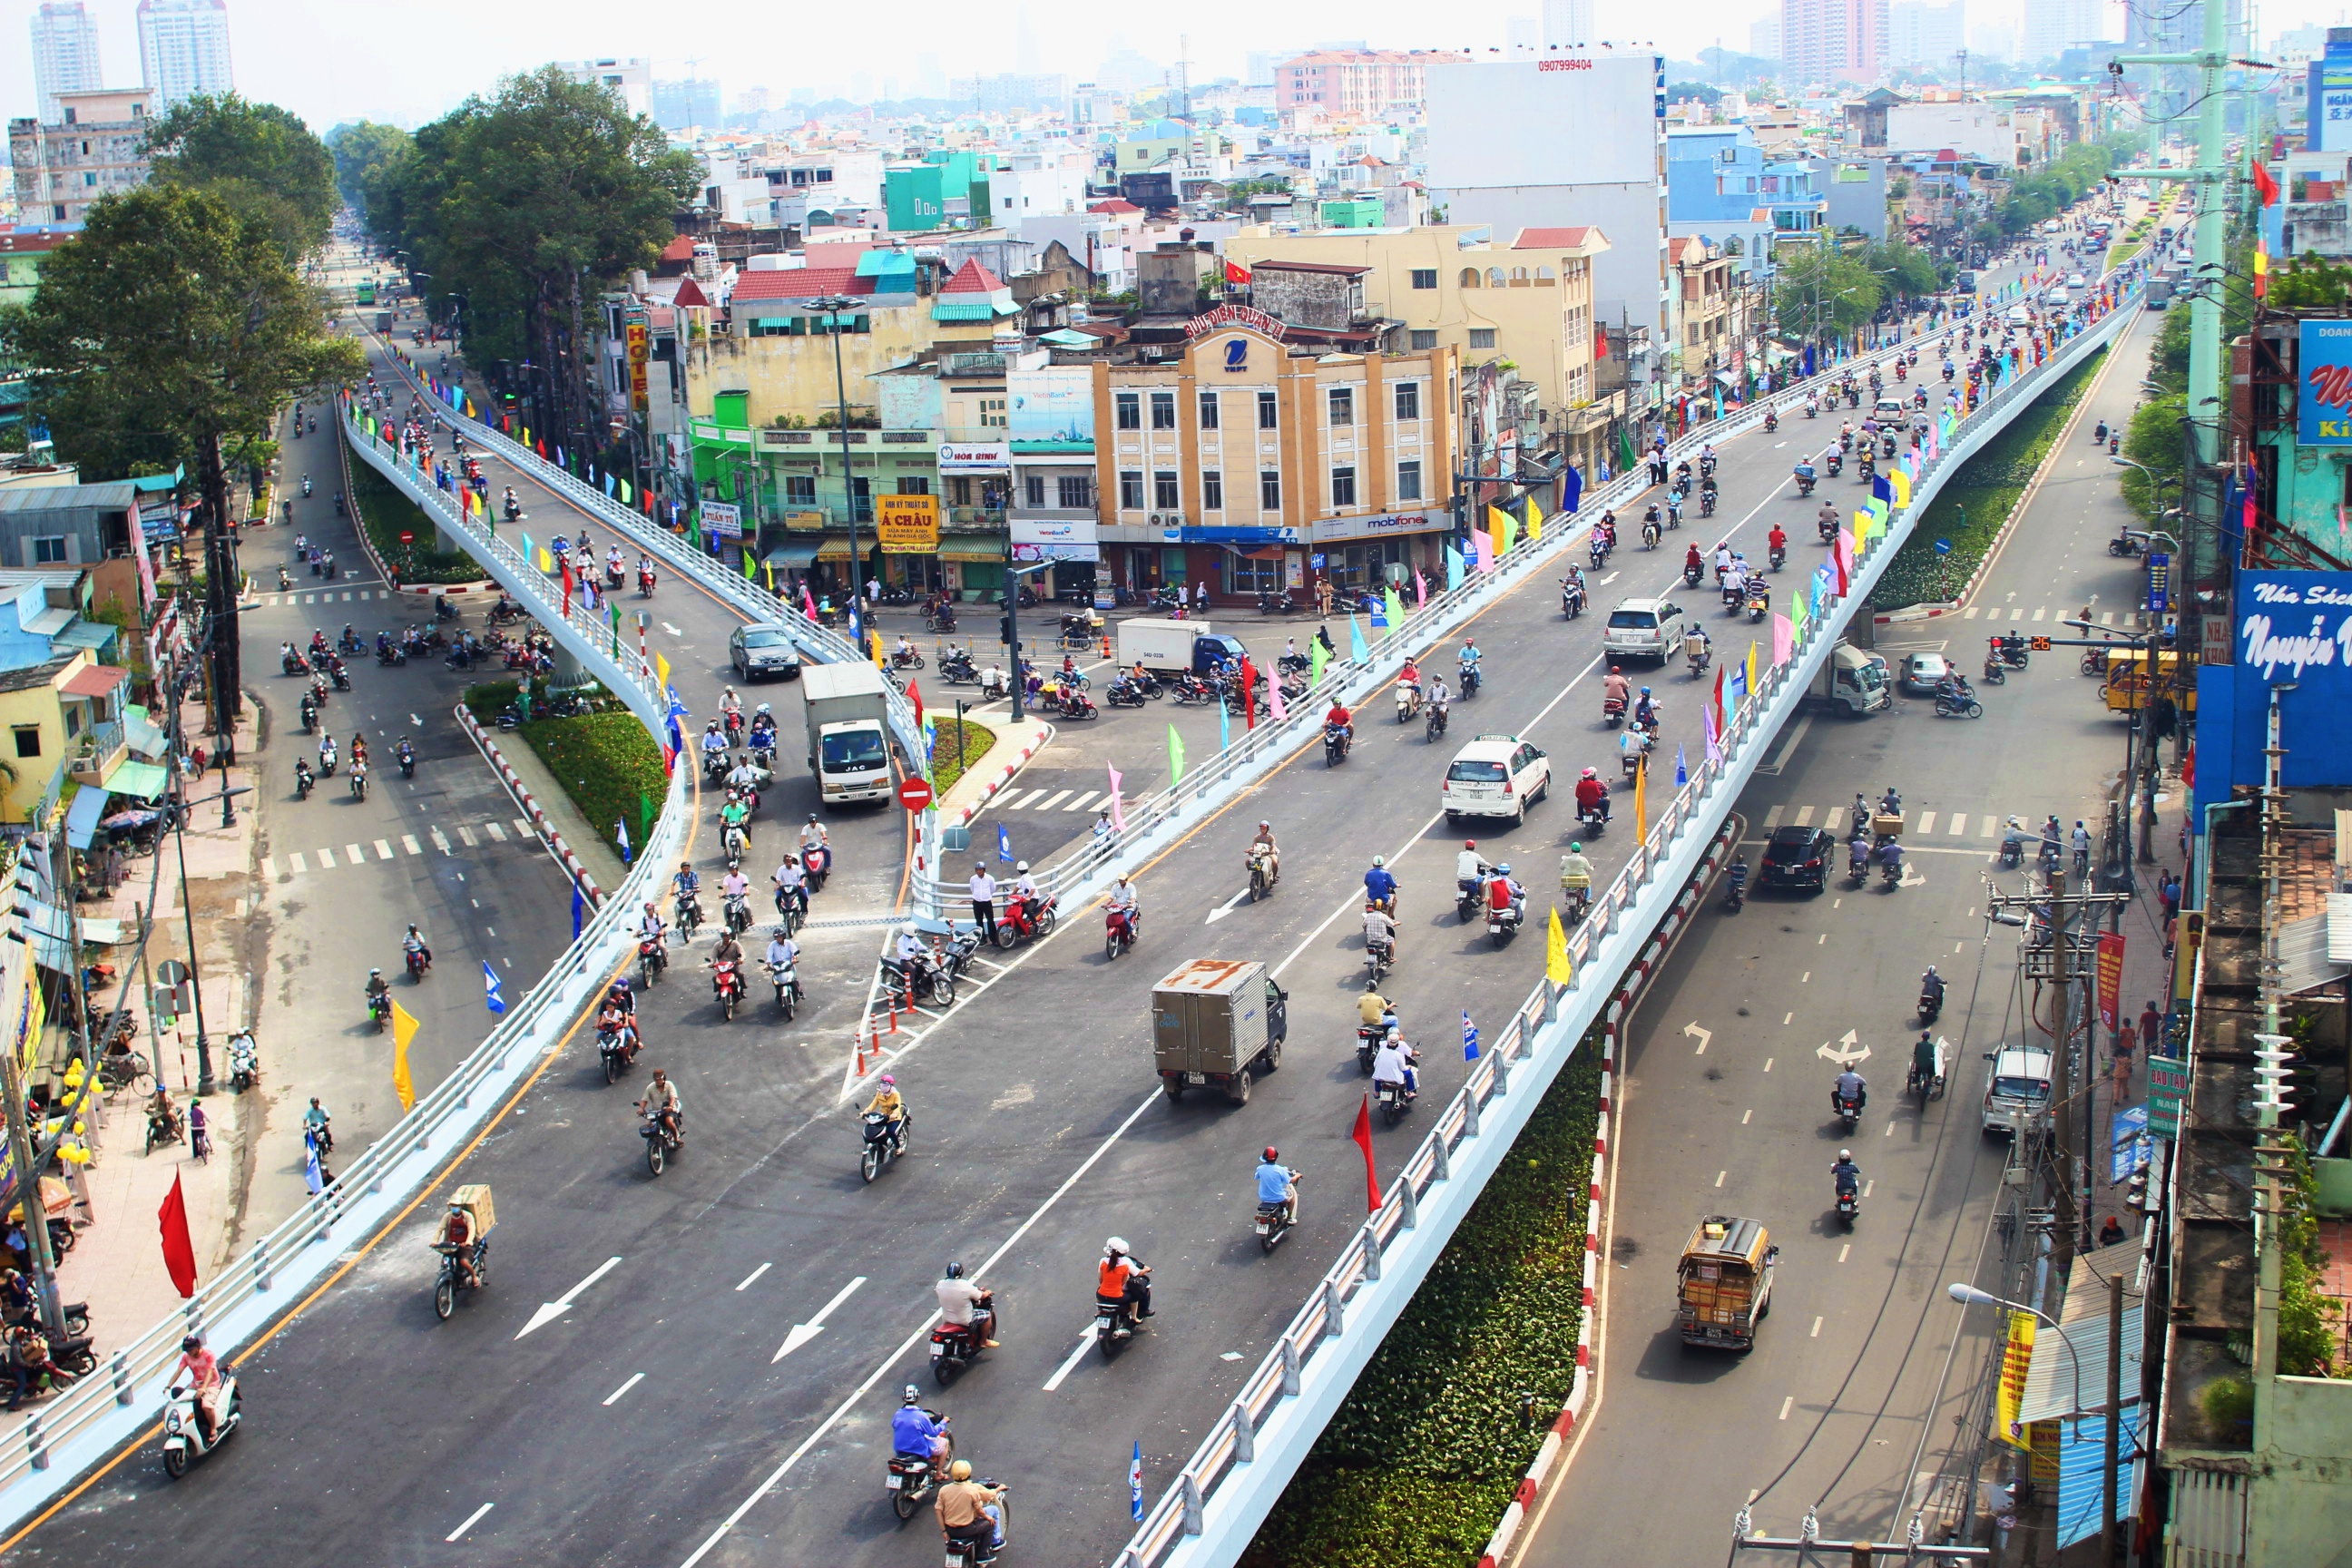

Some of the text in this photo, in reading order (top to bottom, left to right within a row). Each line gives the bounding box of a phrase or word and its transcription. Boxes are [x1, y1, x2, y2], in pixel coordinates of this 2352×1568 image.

[1538, 59, 1592, 72] 0907999404
[895, 513, 932, 525] CHÂU
[1367, 514, 1423, 528] mobifone
[2033, 637, 2049, 650] 26
[2243, 614, 2334, 680] Nguyễn
